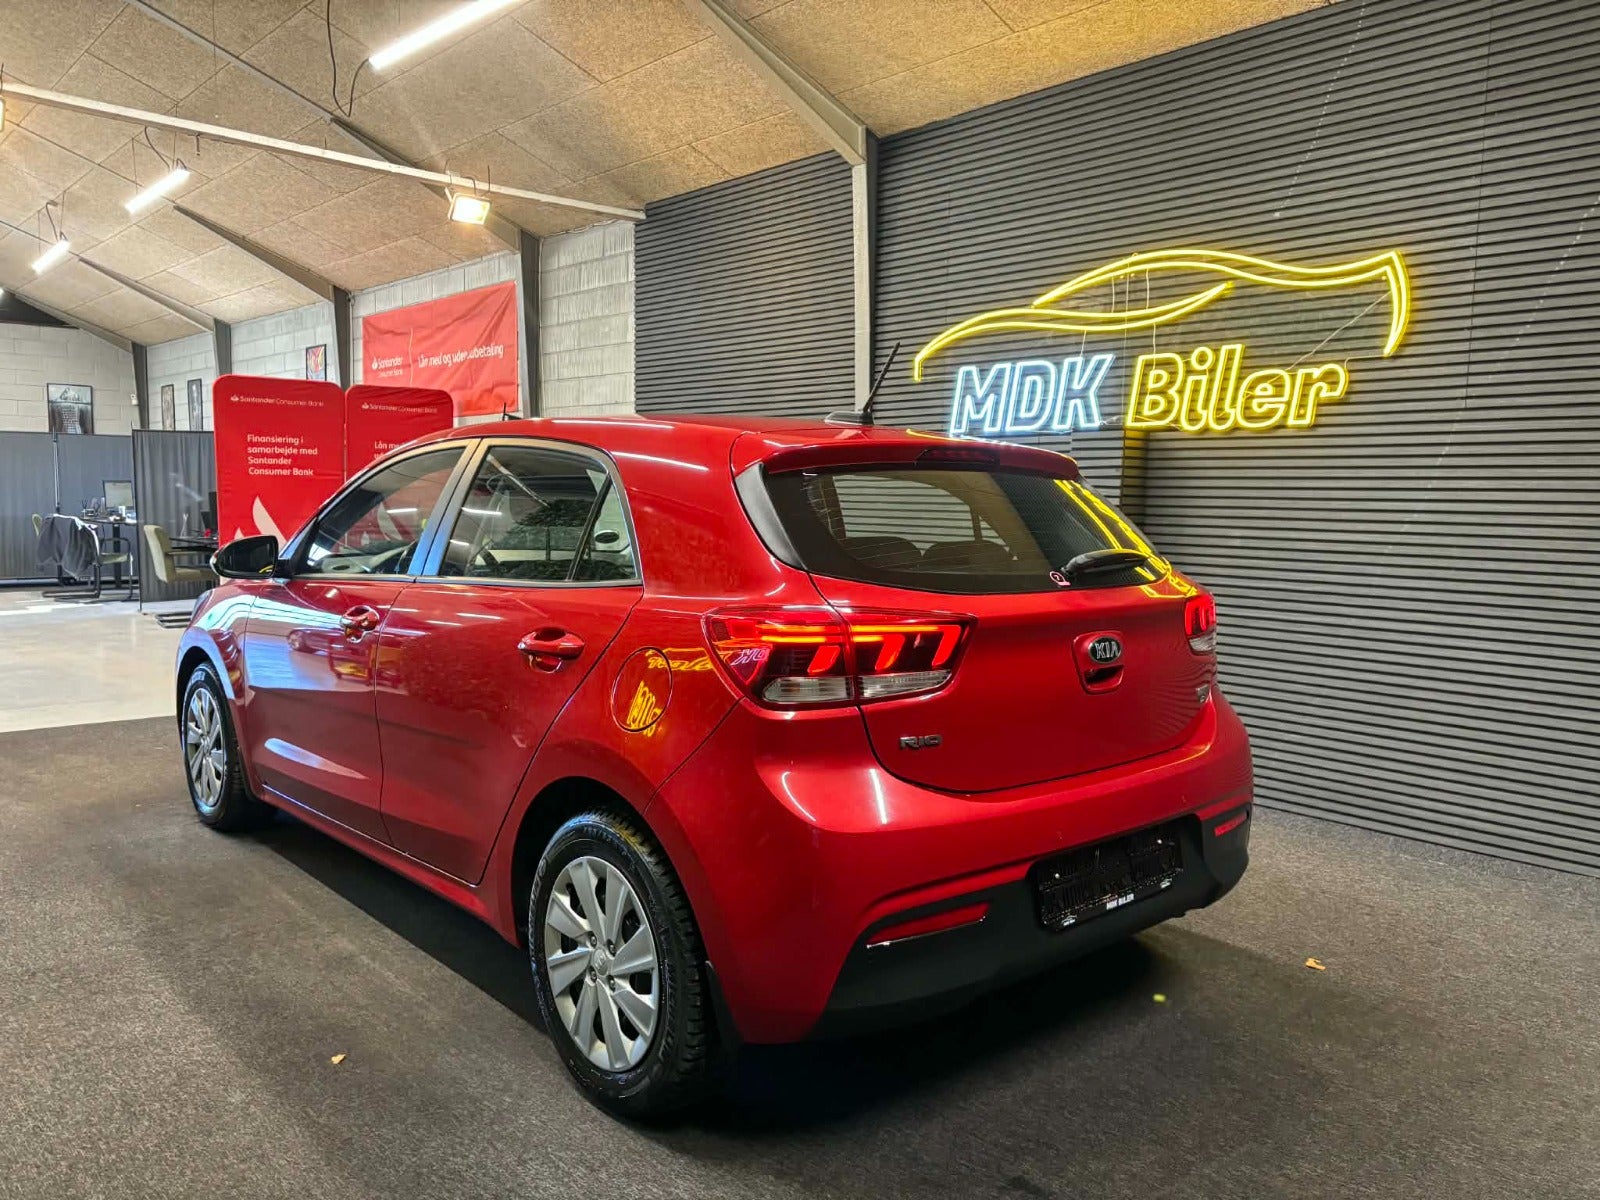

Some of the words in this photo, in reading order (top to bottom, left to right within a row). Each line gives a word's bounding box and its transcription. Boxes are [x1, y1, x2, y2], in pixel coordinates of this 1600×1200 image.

[442, 353, 452, 368] og
[950, 353, 1115, 436] MDK
[1126, 344, 1348, 432] Biler
[240, 395, 275, 405] Santander
[276, 398, 307, 406] Consumer
[247, 434, 300, 446] Finansiering
[374, 439, 388, 450] Lån
[247, 445, 298, 456] samarbejde
[299, 447, 318, 455] med
[247, 456, 292, 465] Santander
[248, 467, 291, 476] Consumer
[292, 467, 314, 476] Bank
[1094, 641, 1120, 660] KIA
[900, 735, 943, 749] RIO
